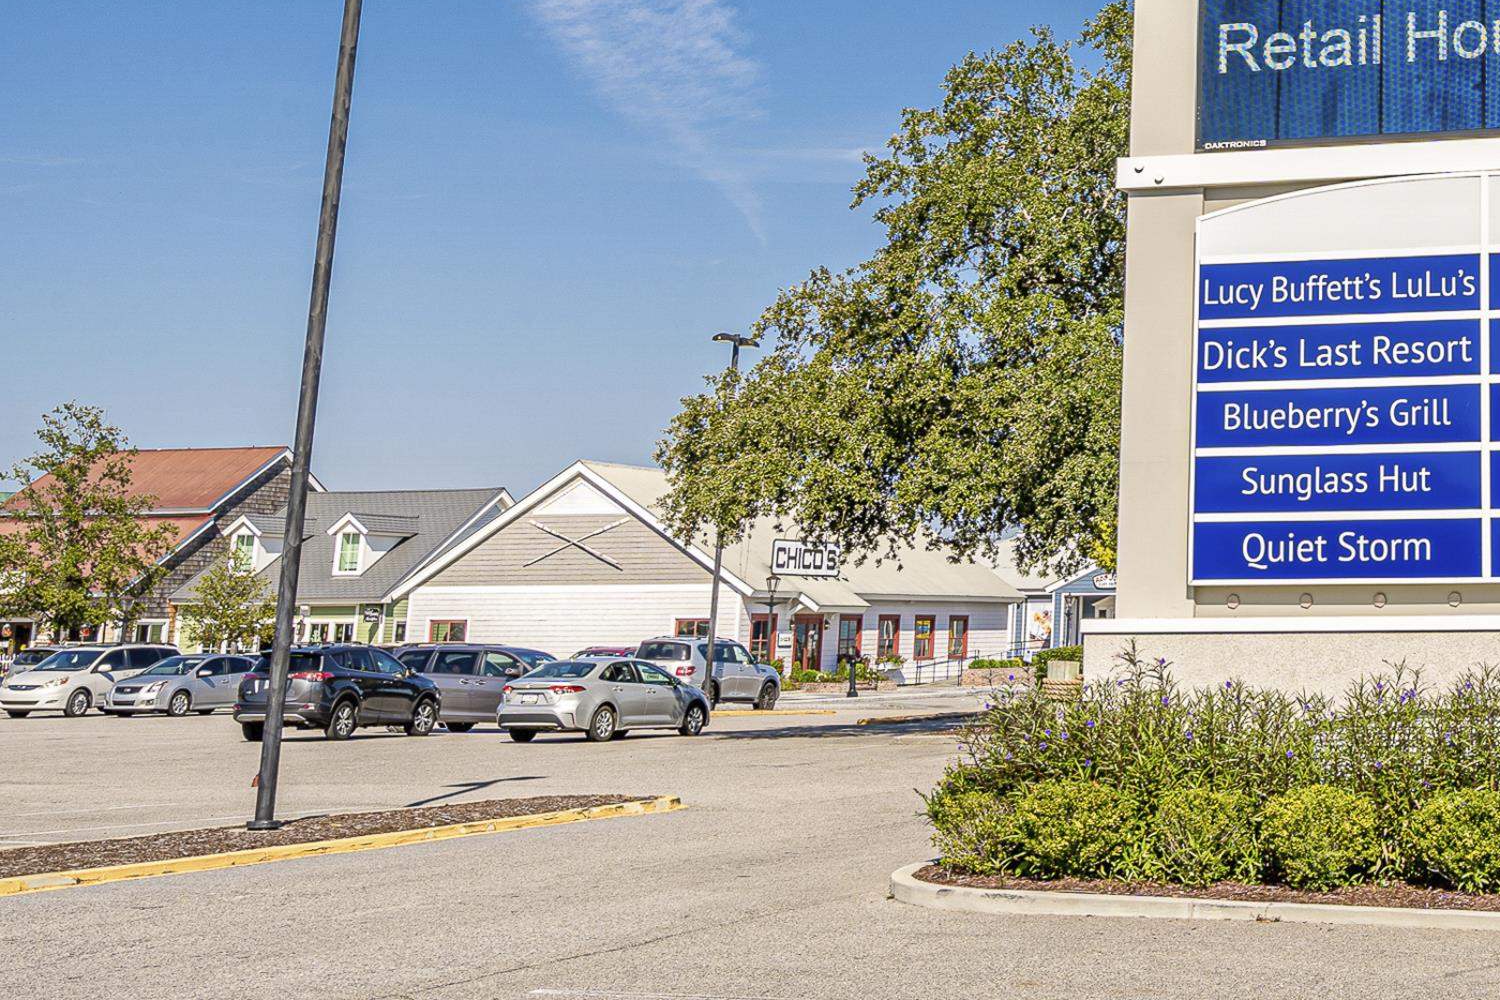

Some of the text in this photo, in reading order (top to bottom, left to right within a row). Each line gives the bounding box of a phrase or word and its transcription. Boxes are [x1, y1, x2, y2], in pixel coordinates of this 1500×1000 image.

[1218, 13, 1381, 74] Retail
[1203, 269, 1476, 310] Lucy Buffett's LuLu's
[1203, 336, 1472, 370] Dick's Last Resort
[1223, 398, 1452, 434] Blueberry's Grill
[1241, 465, 1431, 501] Sunglass Hut
[1242, 530, 1432, 569] Quiet Storm
